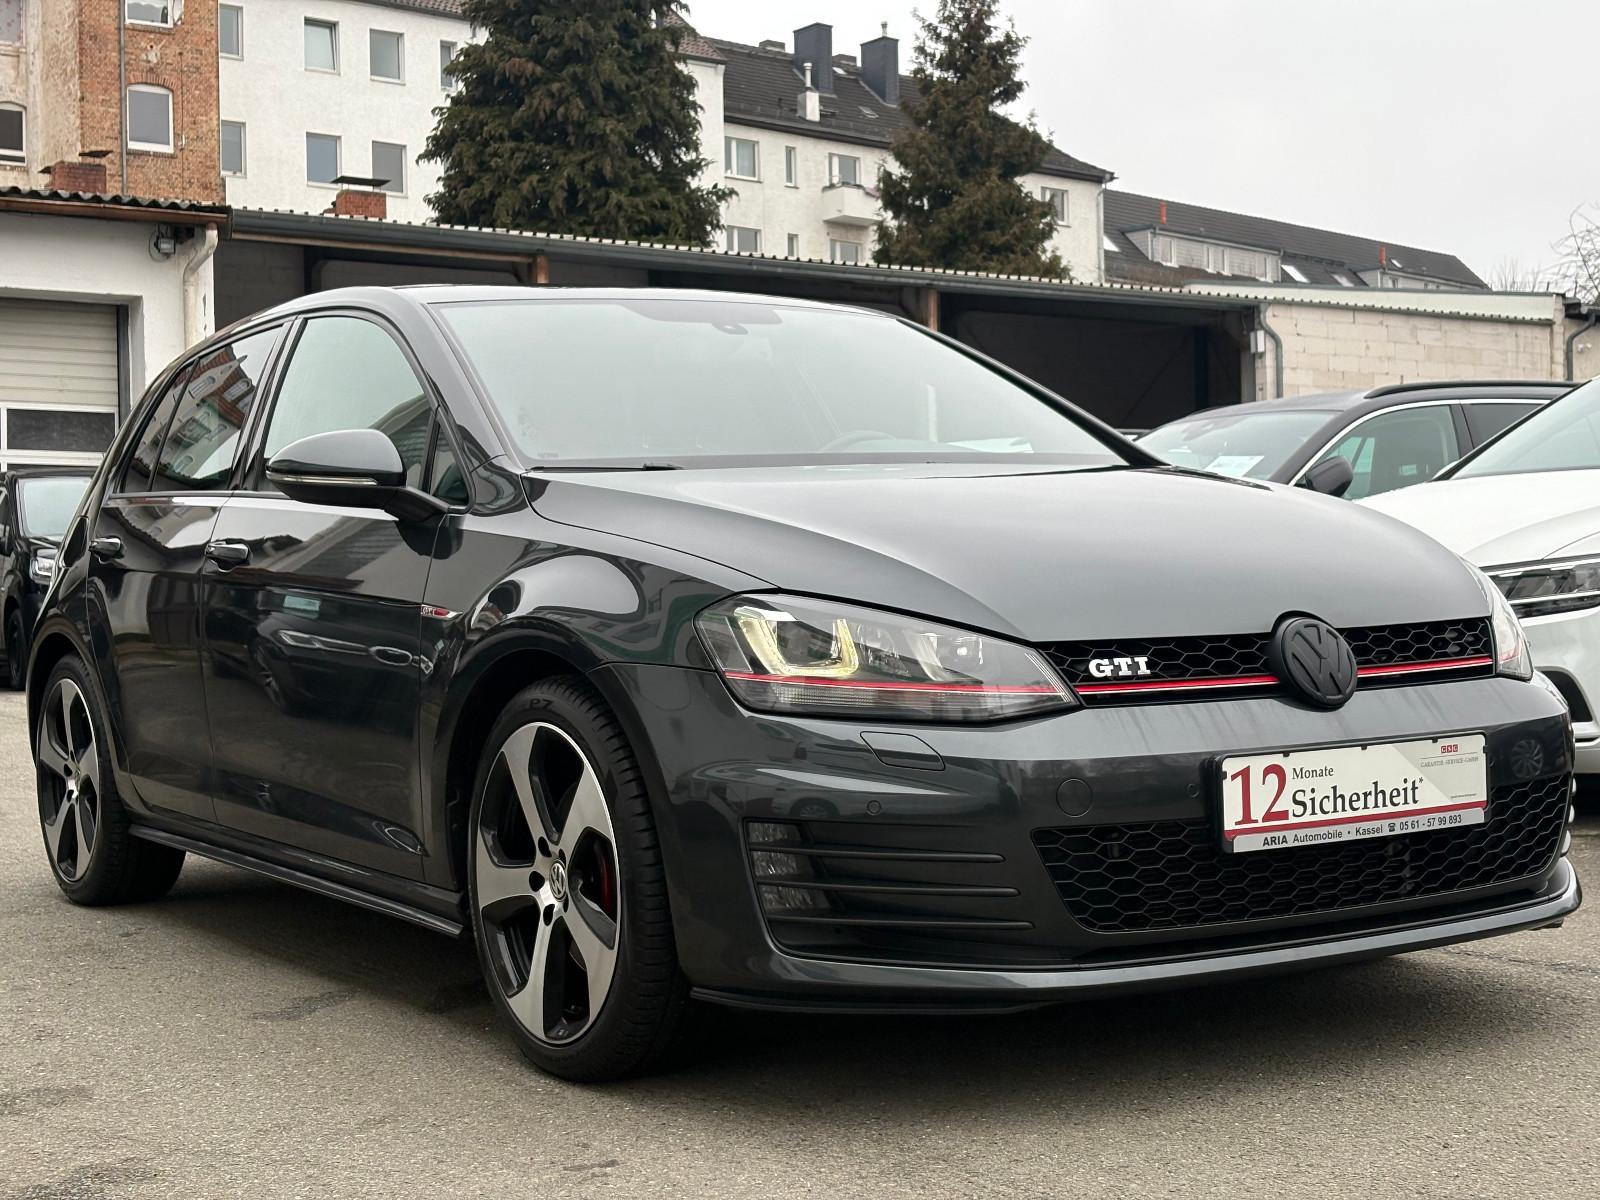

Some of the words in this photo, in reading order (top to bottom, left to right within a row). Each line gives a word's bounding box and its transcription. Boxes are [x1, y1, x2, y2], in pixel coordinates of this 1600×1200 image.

[1088, 656, 1152, 678] GTI
[1291, 765, 1335, 780] Monate
[1230, 763, 1290, 826] 12
[1262, 835, 1289, 847] ARIA
[1292, 829, 1343, 844] Automobile
[1355, 823, 1383, 836] Kassel
[1448, 814, 1462, 824] 893
